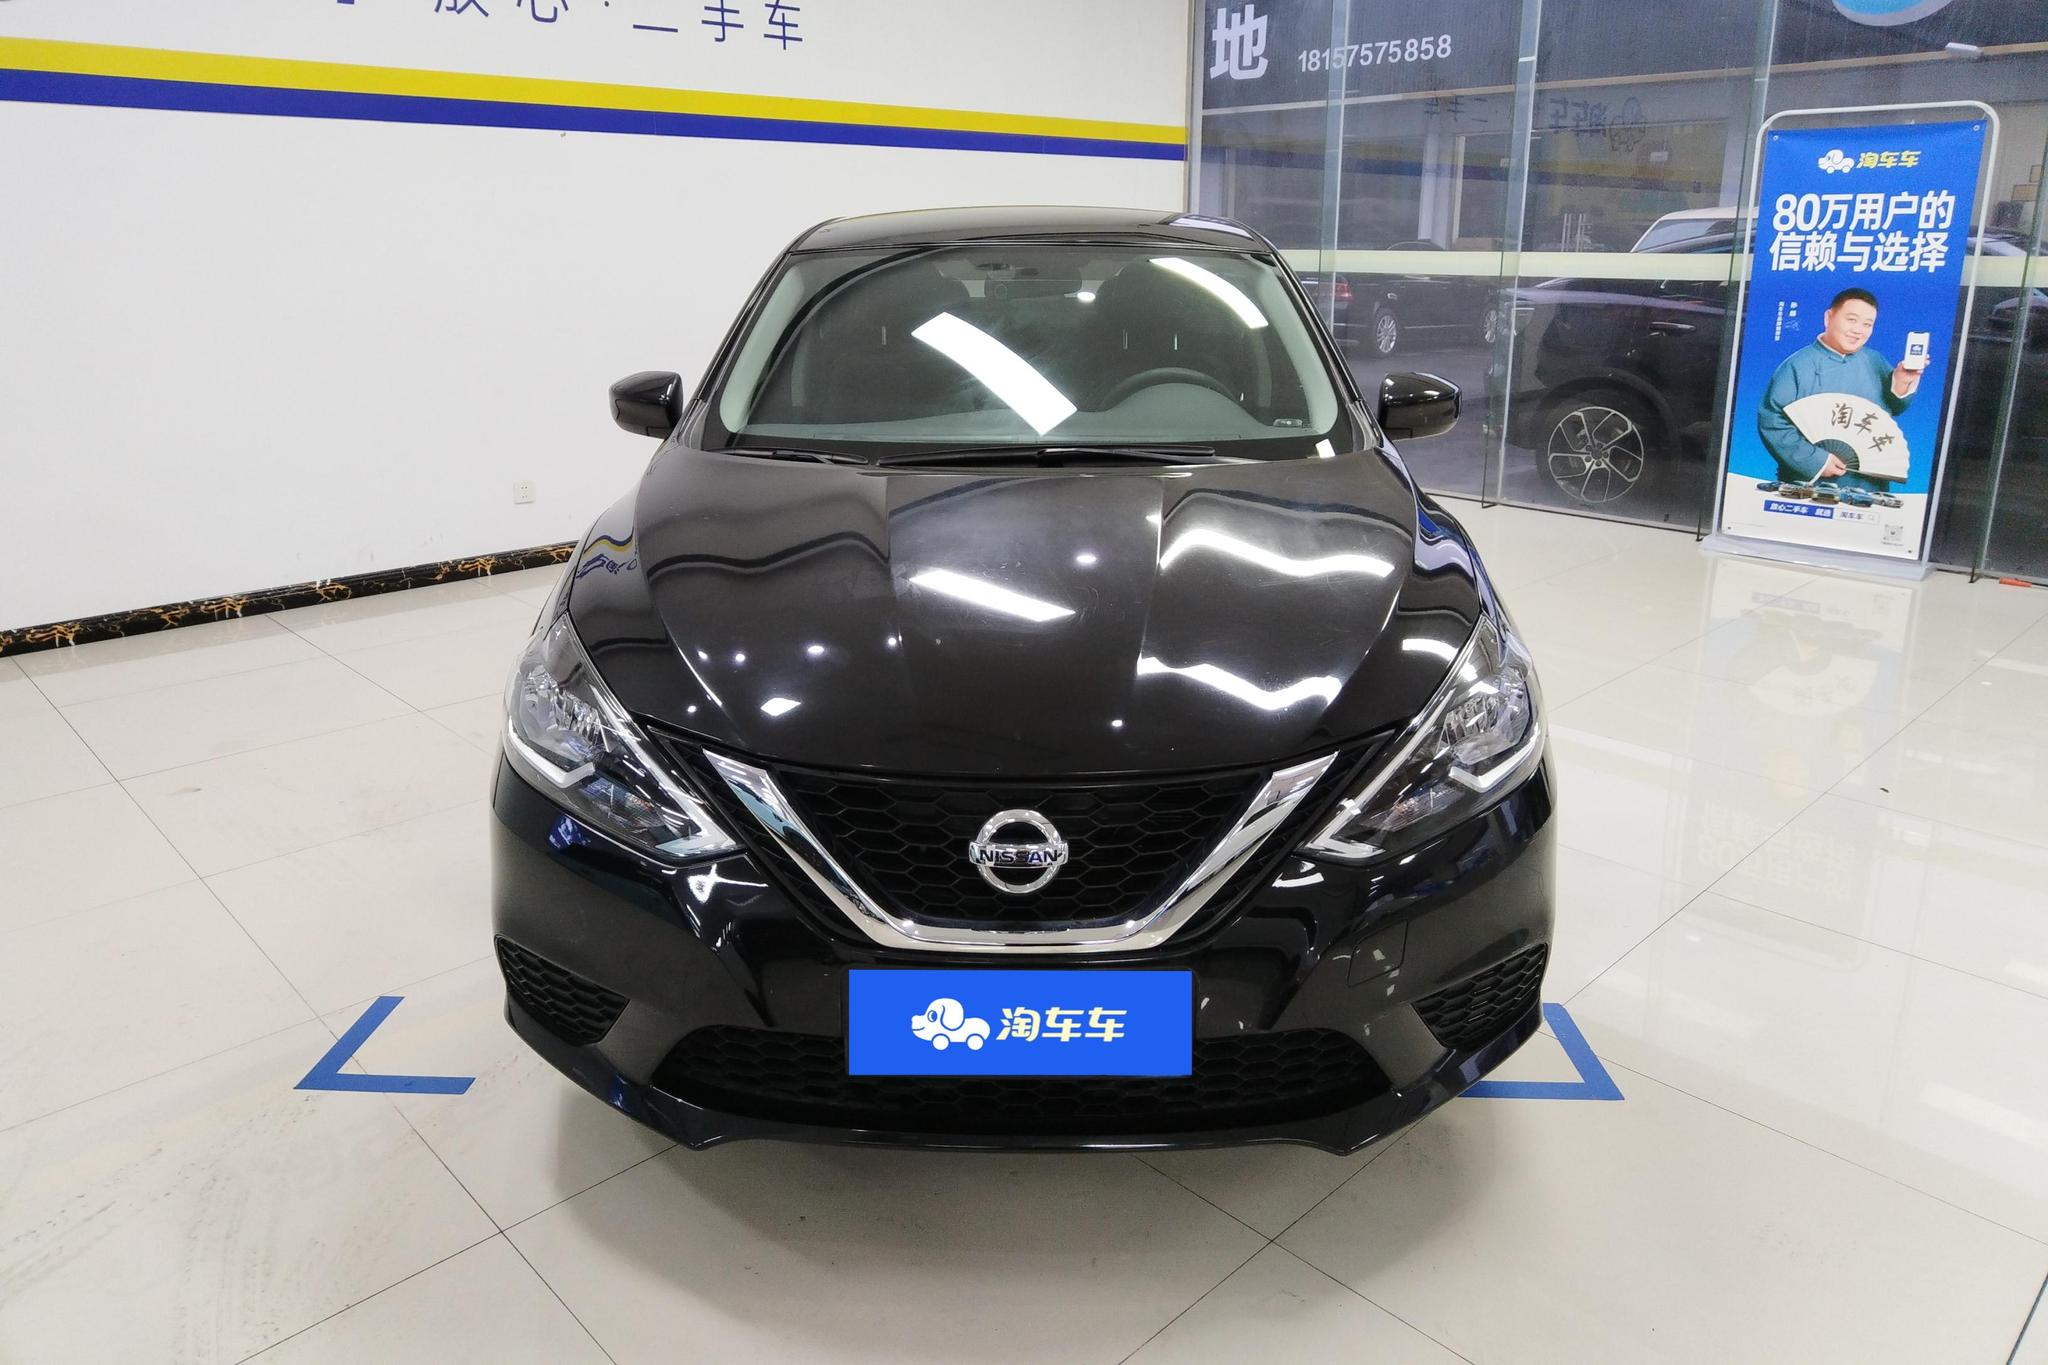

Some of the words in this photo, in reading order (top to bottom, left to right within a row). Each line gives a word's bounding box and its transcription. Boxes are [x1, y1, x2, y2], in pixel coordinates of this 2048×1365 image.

[1210, 3, 1269, 80] 地
[1298, 34, 1453, 73] 18157575858
[1856, 150, 1922, 169] 淘车车
[1772, 190, 1956, 232] 80万用户的
[1769, 230, 1949, 273] 信赖与选择
[1830, 402, 1895, 452] 淘车车
[979, 848, 1058, 863] NISSAN
